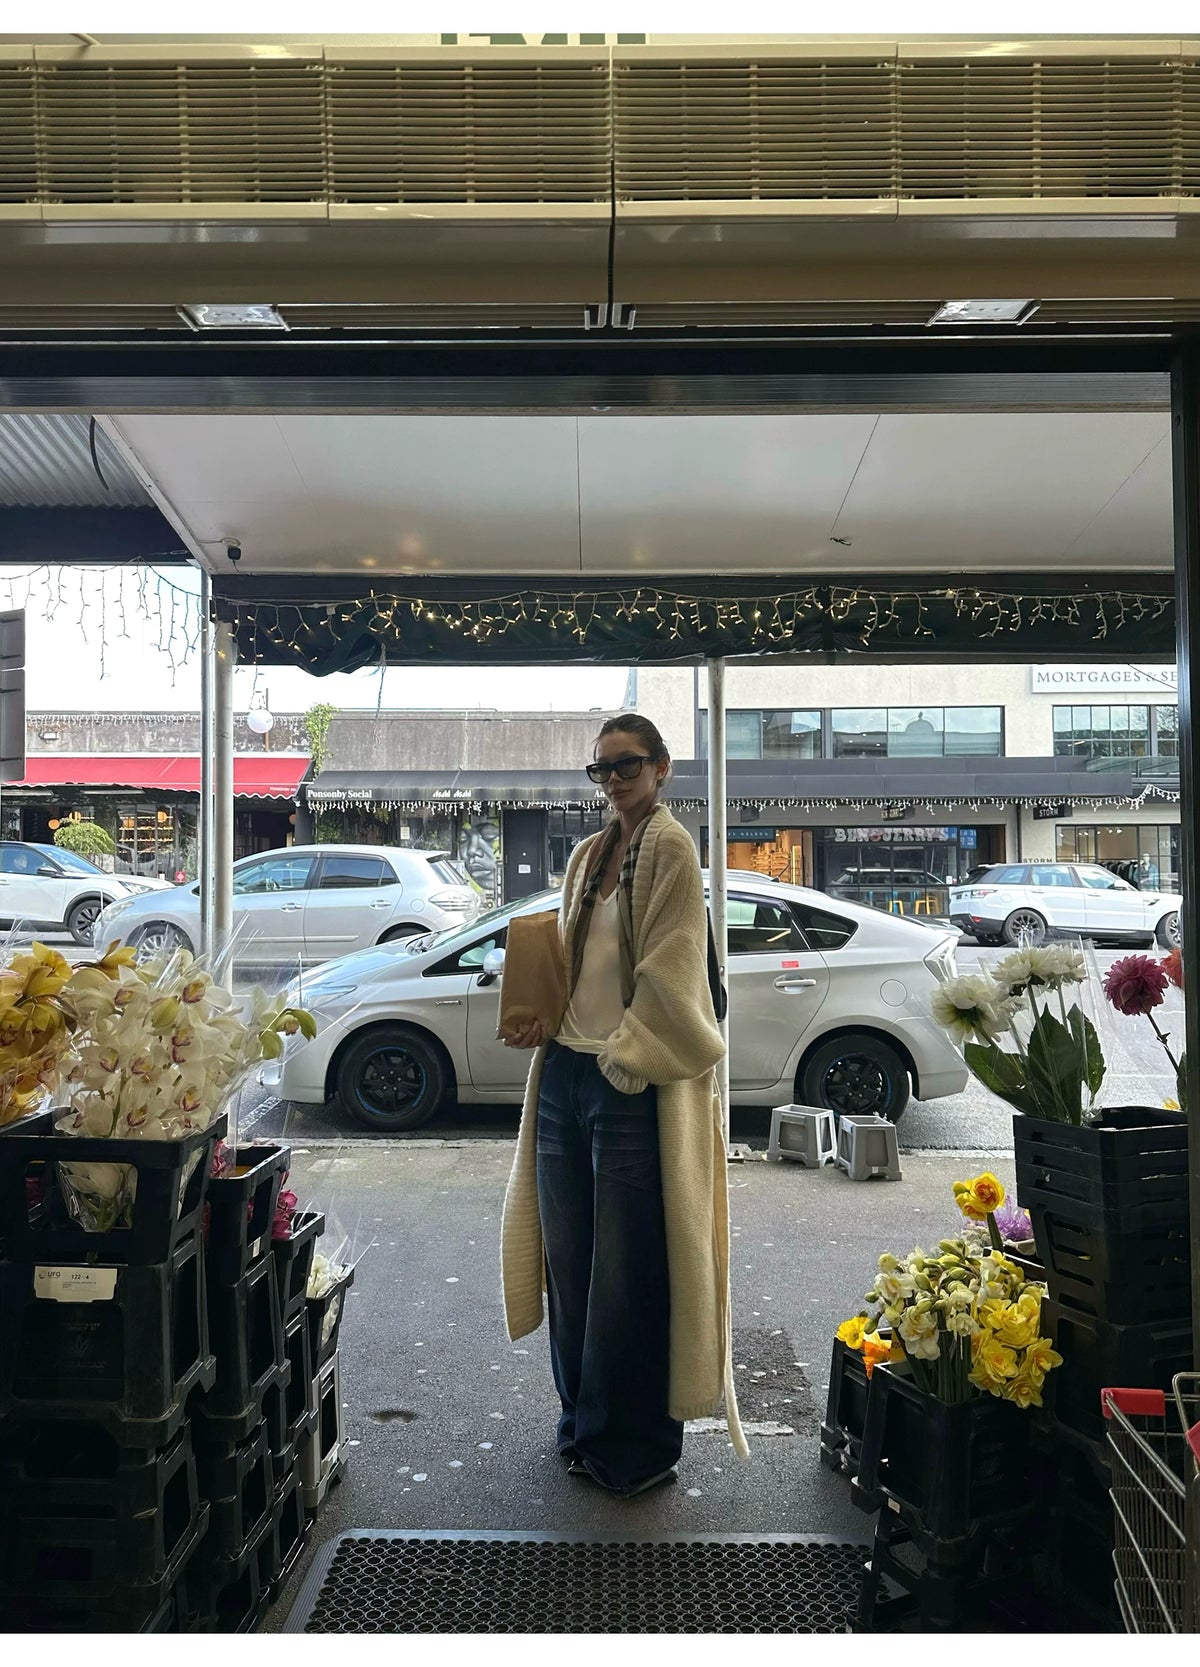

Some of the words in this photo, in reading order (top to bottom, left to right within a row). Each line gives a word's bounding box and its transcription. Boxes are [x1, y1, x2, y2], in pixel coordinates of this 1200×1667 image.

[1037, 671, 1141, 683] MORTGAGES
[1145, 673, 1157, 682] &
[307, 789, 346, 800] Ponsonby
[347, 789, 373, 799] Social
[1039, 808, 1059, 817] STORM
[834, 828, 870, 842] BEN
